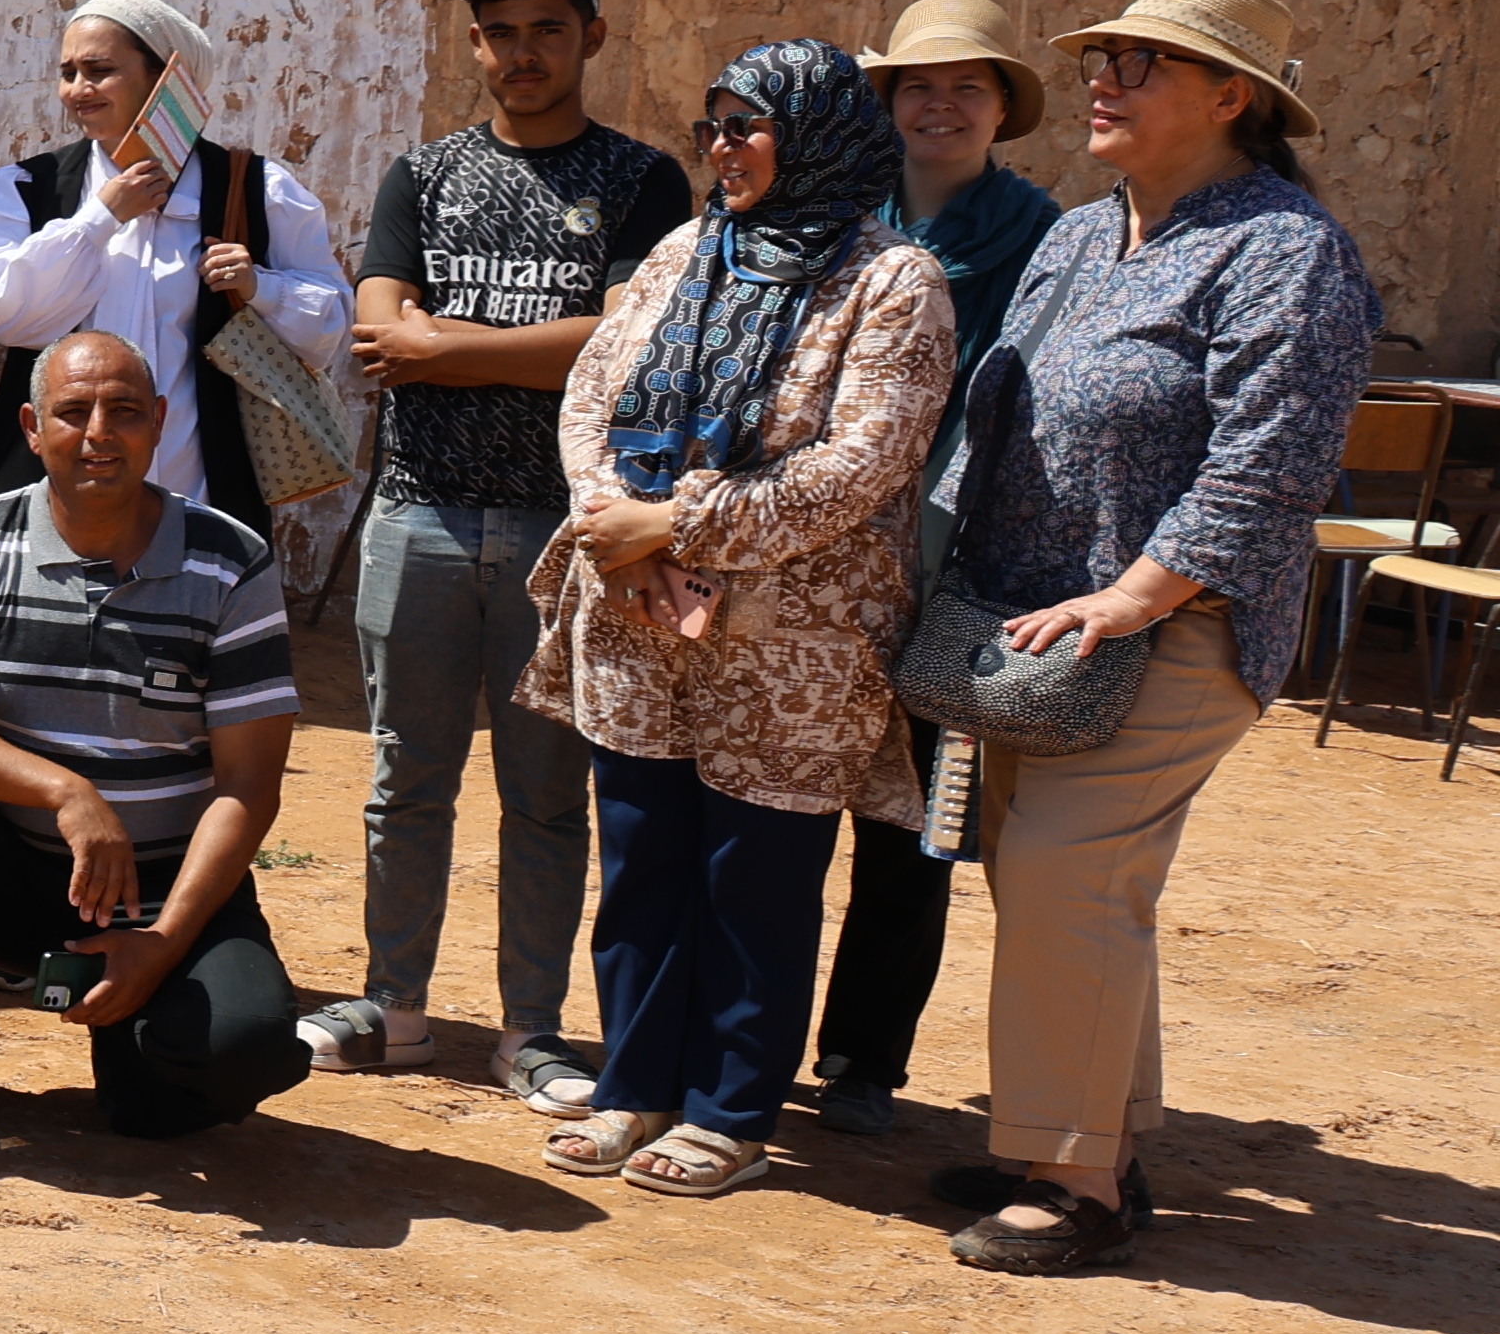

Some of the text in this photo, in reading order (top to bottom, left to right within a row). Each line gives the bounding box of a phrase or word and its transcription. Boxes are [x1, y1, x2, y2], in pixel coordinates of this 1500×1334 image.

[423, 249, 594, 291] Emirates
[445, 288, 563, 324] FLY BETTER
